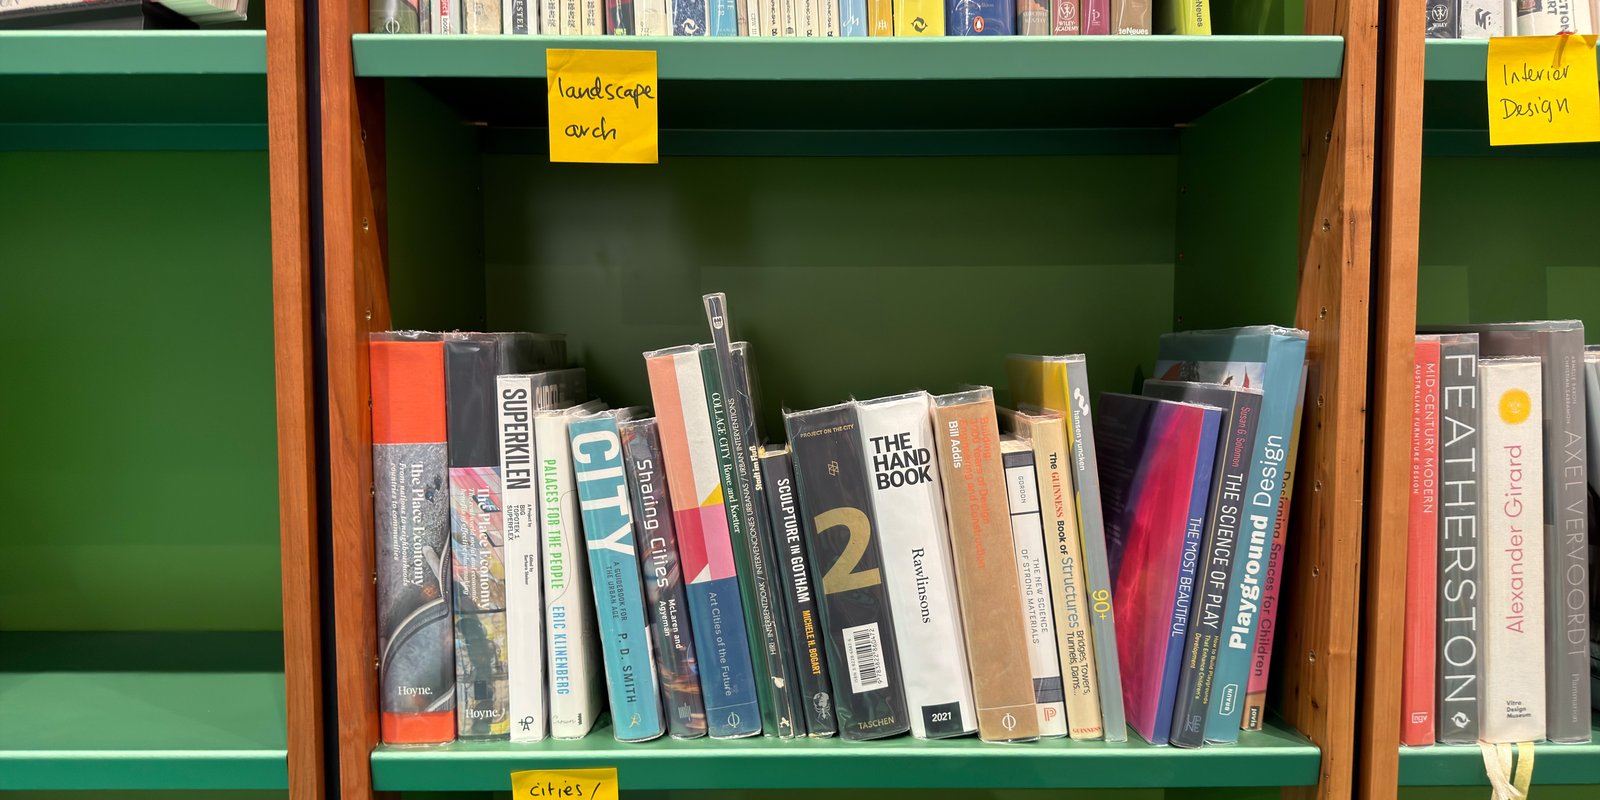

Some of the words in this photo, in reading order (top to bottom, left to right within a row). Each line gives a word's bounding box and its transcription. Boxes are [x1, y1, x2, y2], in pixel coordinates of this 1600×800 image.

[1503, 63, 1569, 86] Interior
[558, 76, 655, 108] landscape
[1500, 97, 1569, 123] Design
[565, 116, 616, 140] arch
[712, 392, 726, 436] COLLAGE
[1239, 407, 1250, 427] Susan
[1424, 363, 1434, 456] MID-CENTURY
[727, 398, 742, 451] INTERVENTIONS
[800, 429, 822, 438] PROJECT
[949, 421, 958, 437] Bill
[502, 388, 531, 490] SUPERKILEN
[719, 437, 730, 459] CITY
[870, 432, 912, 453] THE
[1232, 437, 1245, 468] Solomon
[736, 452, 747, 475] URBAN
[751, 462, 760, 472] im
[873, 448, 930, 472] HAND
[951, 439, 962, 468] Addis
[1076, 438, 1085, 471] yuncken
[1564, 431, 1582, 491] AXEL
[411, 461, 424, 485] The
[544, 459, 558, 503] PALACES
[723, 464, 733, 485] Rowe
[753, 473, 763, 490] Stadt
[876, 465, 932, 490] BOOK
[978, 476, 985, 485] of
[1224, 473, 1243, 501] THE
[1424, 458, 1434, 513] MODERN
[1504, 445, 1523, 518] Girard
[478, 486, 489, 509] The
[572, 430, 635, 556] CITY
[727, 488, 736, 503] and
[741, 484, 753, 515] URBANAS
[967, 484, 977, 500] and
[1018, 476, 1026, 504] GORDON
[1051, 472, 1063, 518] GUINNESS
[392, 501, 397, 509] to
[412, 488, 425, 525] Place
[547, 507, 560, 526] FOR
[730, 504, 741, 533] Koetter
[777, 479, 800, 544] SCULPTURE
[401, 516, 407, 524] to
[479, 513, 489, 547] Place
[637, 460, 659, 530] Sharing
[651, 537, 669, 587] Cities
[1057, 520, 1066, 542] Book
[1187, 517, 1201, 541] THE
[1445, 354, 1476, 701] FEATHERSTON
[548, 529, 562, 547] THE
[789, 545, 801, 555] IN
[1060, 544, 1068, 555] of
[1212, 506, 1237, 566] SCIENCE
[1228, 515, 1268, 649] Playground
[1253, 435, 1284, 507] Design
[401, 526, 409, 587] neighbourhoods
[412, 528, 425, 587] Economy
[814, 507, 881, 594] 2
[1022, 550, 1028, 560] OF
[1183, 541, 1197, 574] MOST
[479, 550, 490, 610] Economy
[549, 550, 564, 589] PEOPLE
[791, 556, 810, 603] GOTHAM
[1023, 562, 1033, 595] STRONG
[1210, 571, 1227, 589] OF
[1266, 543, 1281, 591] Spaces
[1505, 526, 1524, 633] Alexander
[1566, 499, 1587, 657] VERVOORDT
[608, 580, 617, 604] URBAN
[614, 569, 625, 606] GUIDEBOOK
[709, 592, 718, 606] Art
[912, 547, 931, 624] Rawlinsons
[1062, 557, 1079, 628] Structures
[552, 606, 566, 629] ERIC
[611, 606, 619, 619] AGE
[619, 609, 628, 621] FOR
[1038, 597, 1048, 633] SCIENCE
[1092, 590, 1110, 620] 90+
[1172, 577, 1192, 637] BEAUTIFUL
[1203, 594, 1222, 629] PLAY
[1263, 593, 1275, 614] for
[659, 601, 669, 636] Agyeman
[668, 599, 679, 631] McLaren
[674, 633, 683, 648] and
[712, 609, 721, 634] Cities
[802, 610, 814, 637] MICHELE
[1027, 598, 1039, 644] MATERIALS
[618, 633, 627, 644] P.
[717, 637, 726, 648] of
[808, 638, 815, 647] H.
[1067, 632, 1077, 665] Tunnels,
[1255, 618, 1271, 677] Children
[554, 634, 569, 695] KLINENBERG
[620, 648, 629, 660] D.
[718, 648, 727, 665] the
[810, 648, 821, 675] BOGART
[1076, 630, 1086, 663] Bridges,
[1081, 663, 1091, 695] Towers,
[398, 685, 433, 697] Hoyne.
[623, 665, 636, 703] SMITH
[721, 665, 731, 696] Future
[465, 708, 501, 720] Hoyne.
[858, 716, 895, 730] TASCHEN
[932, 712, 951, 722] 2021
[530, 781, 583, 797] cities
